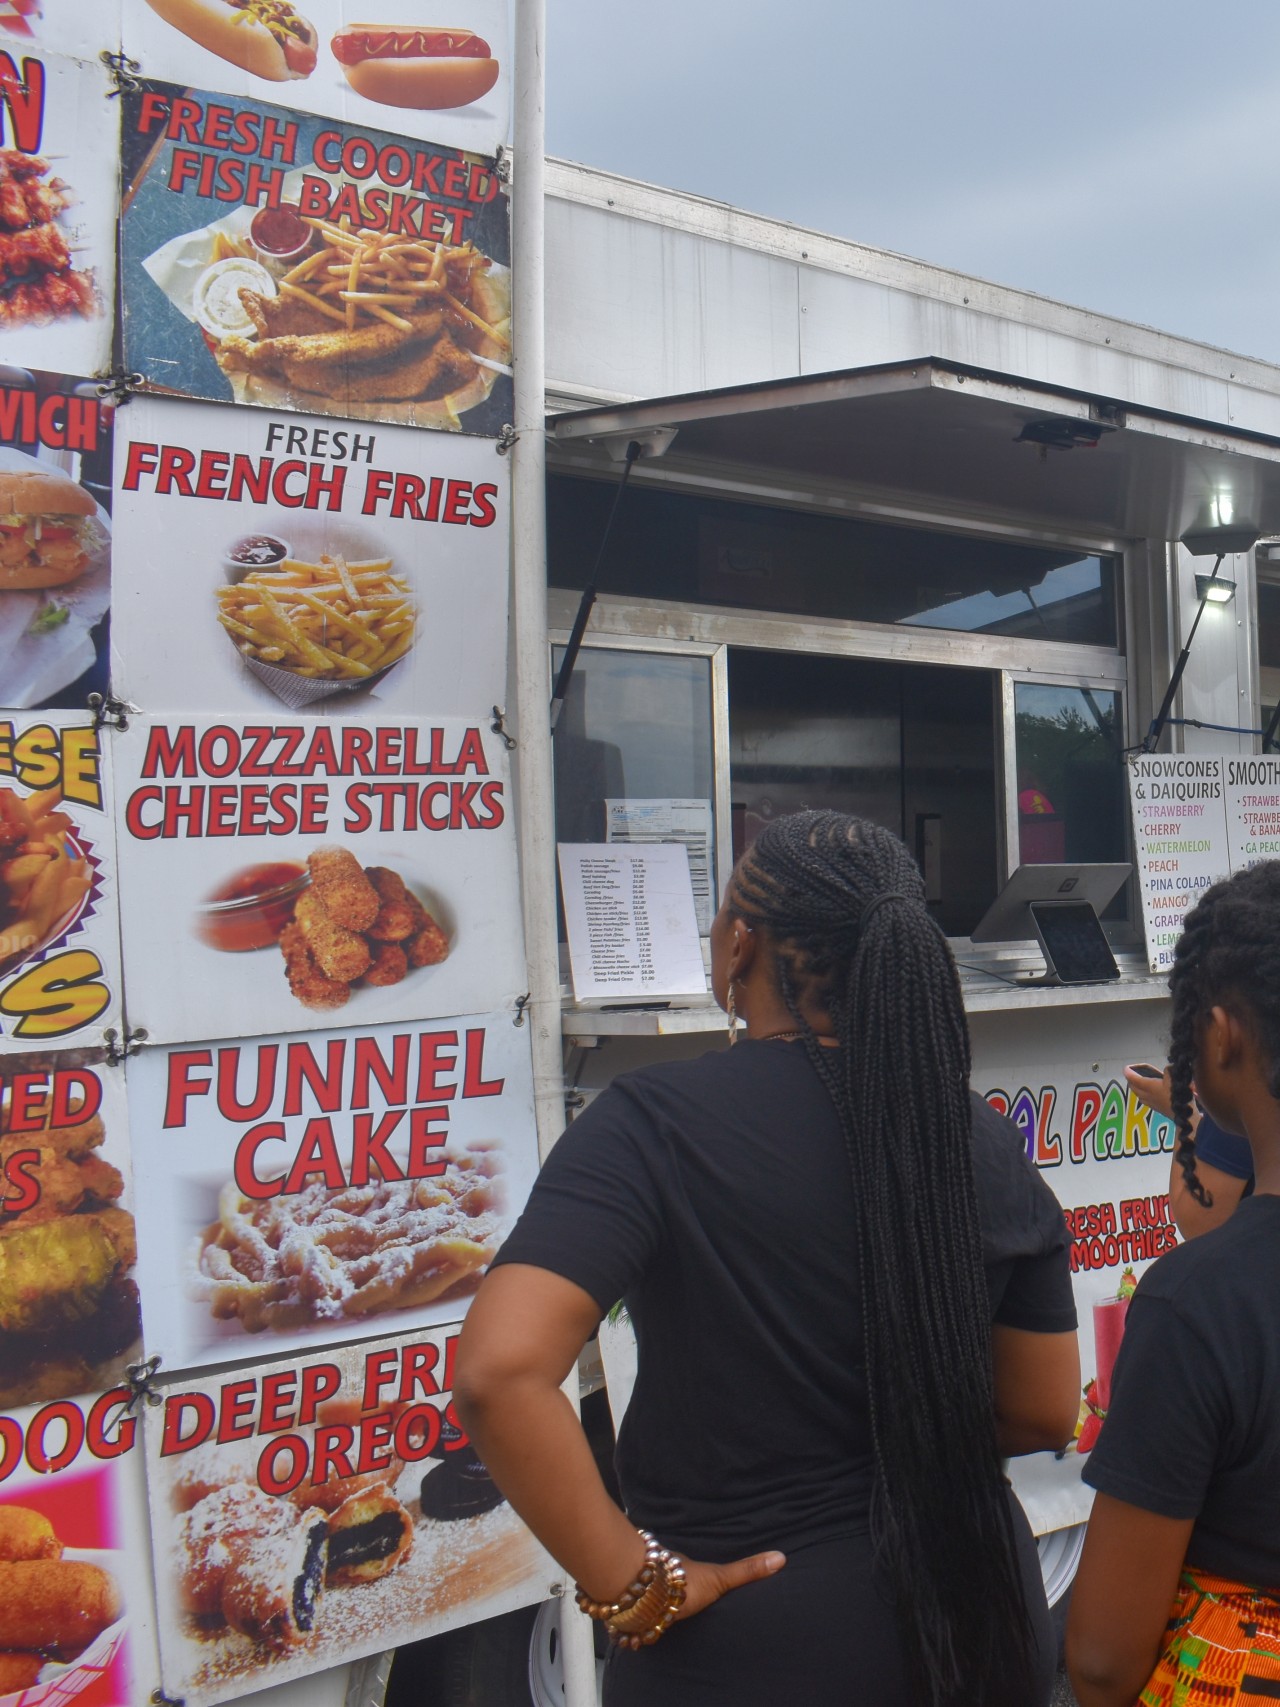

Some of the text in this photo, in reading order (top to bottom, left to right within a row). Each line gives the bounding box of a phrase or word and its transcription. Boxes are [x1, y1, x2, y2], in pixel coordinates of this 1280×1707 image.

[137, 92, 498, 204] FRESH COOKED
[167, 148, 473, 246] FISH BASKET
[265, 422, 376, 464] FRESH
[121, 440, 498, 528] FRENCH FRIES
[140, 725, 490, 779] MOZZARELLA
[1133, 760, 1219, 778] SNOWCONES
[125, 780, 506, 840] CHEESE STICKS
[1135, 782, 1221, 801] & DAIQUIRIS
[1142, 804, 1205, 818] STRAWBERRY
[1144, 823, 1181, 836] CHERRY
[1146, 840, 1211, 855] WATERMELON
[1245, 842, 1257, 854] GA
[1250, 825, 1257, 836] &
[1148, 860, 1179, 873] PEACH
[1150, 875, 1212, 891] PINA COLADA
[1152, 895, 1189, 909] MANGO
[1154, 914, 1185, 928] GRAPE
[1159, 952, 1177, 965] BLU
[162, 1028, 506, 1130] FUNNEL
[0, 1067, 103, 1135] ED
[233, 1105, 450, 1200] CAKE
[1063, 1202, 1117, 1240] RESH
[1068, 1225, 1178, 1273] MOOTHIES
[159, 1333, 461, 1459] DEEP FRI
[256, 1399, 472, 1496] OREOS
